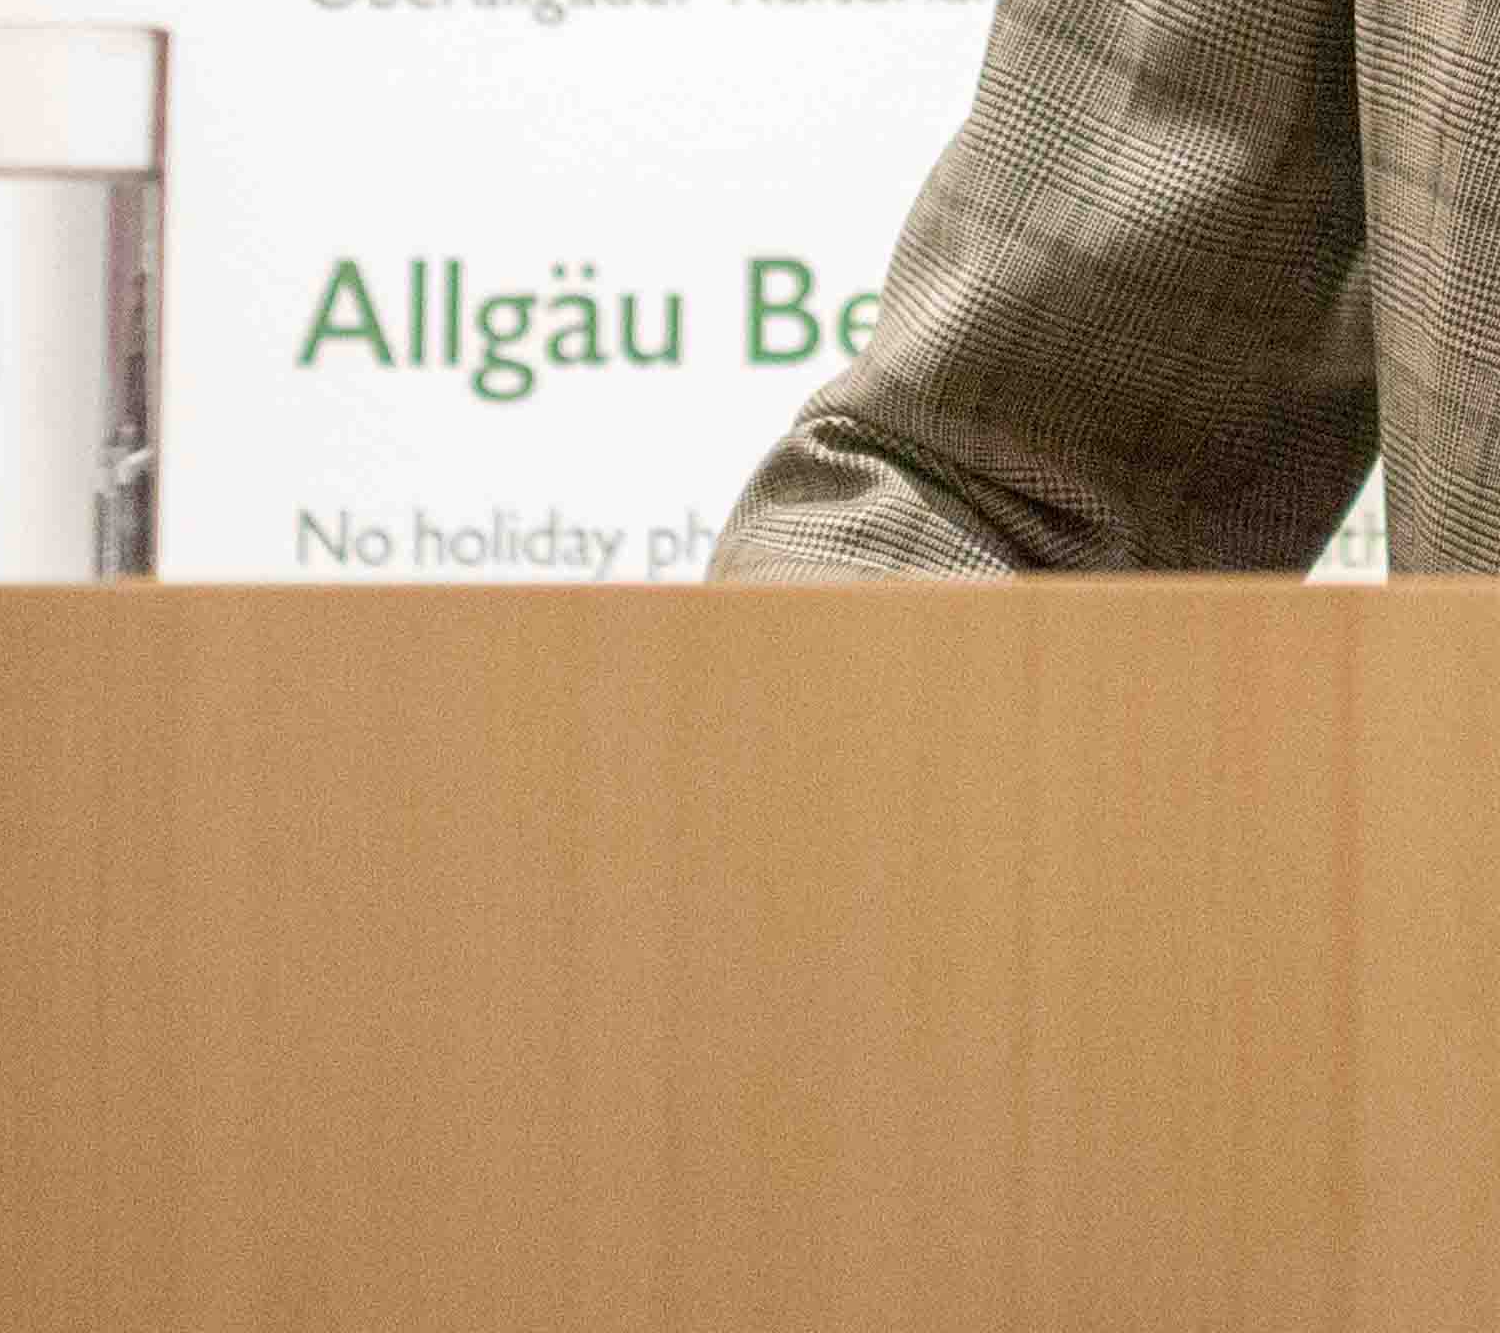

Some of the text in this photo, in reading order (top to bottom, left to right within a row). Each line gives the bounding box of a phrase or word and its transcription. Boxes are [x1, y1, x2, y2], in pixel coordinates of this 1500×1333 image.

[298, 255, 685, 402] Allgäu
[298, 511, 392, 569] No
[414, 508, 627, 580] holiday
